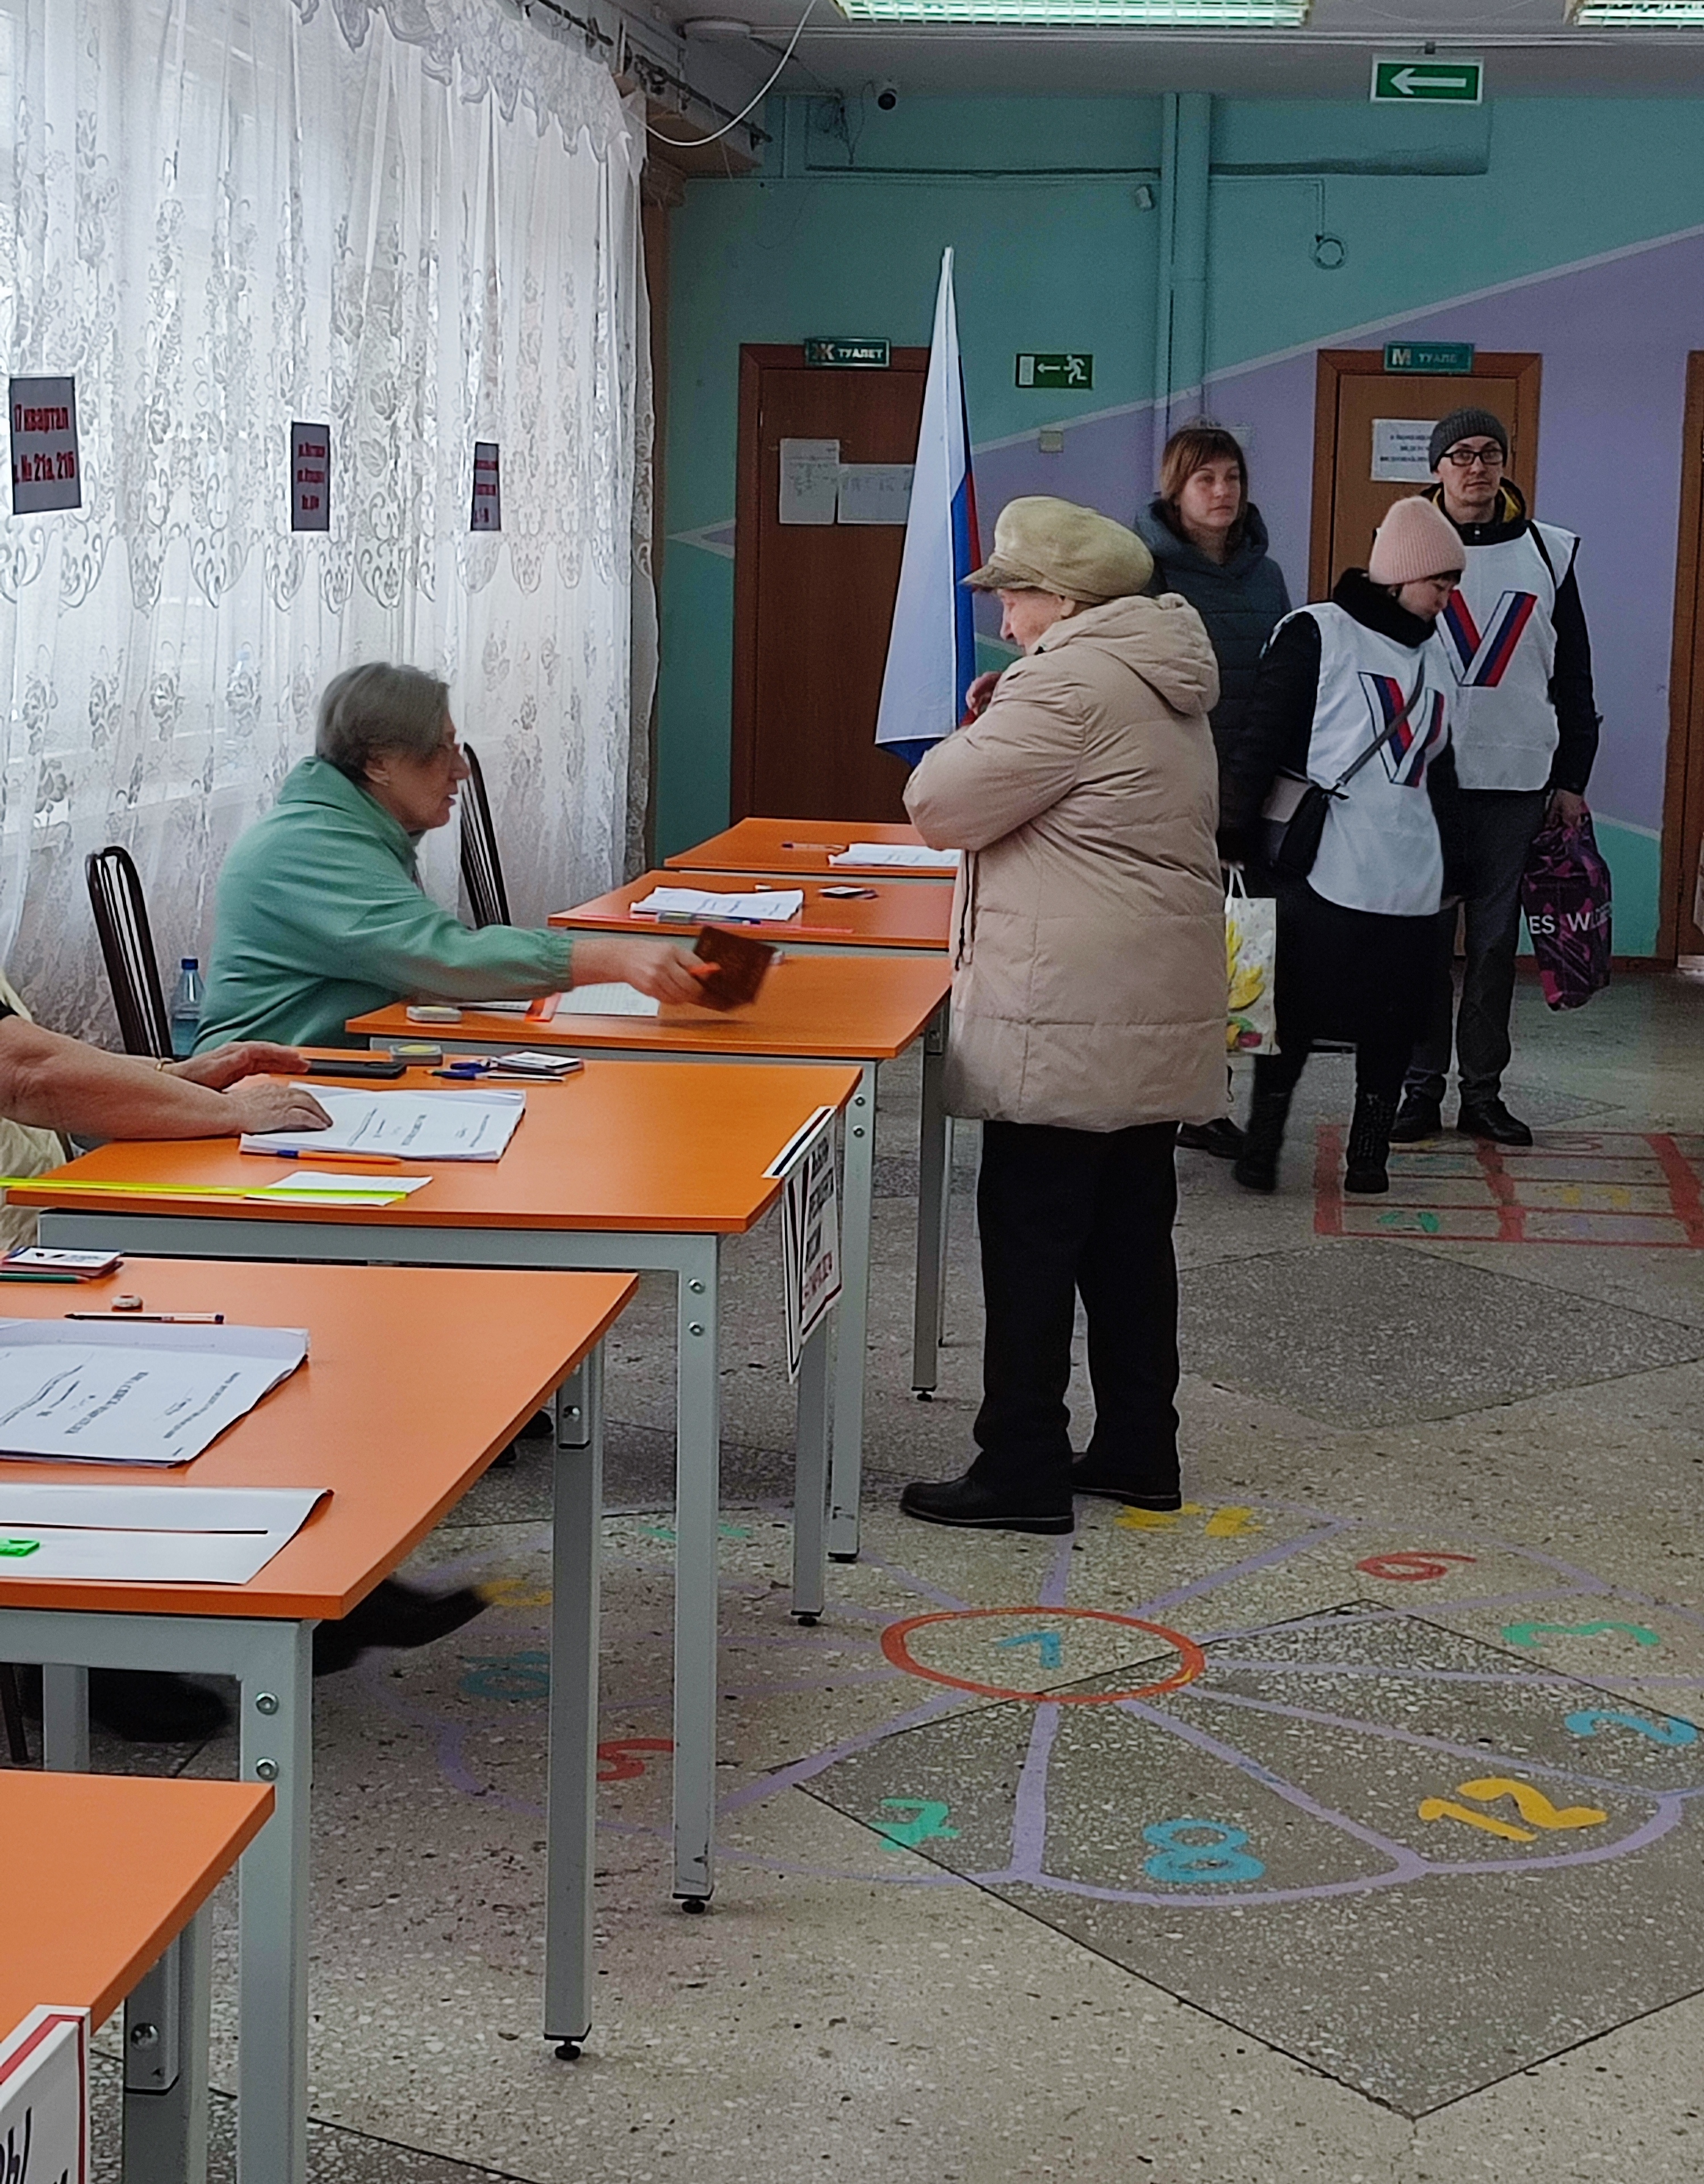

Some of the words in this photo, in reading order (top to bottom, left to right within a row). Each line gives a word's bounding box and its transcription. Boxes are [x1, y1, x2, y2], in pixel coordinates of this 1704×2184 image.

[812, 343, 835, 361] Ж
[838, 348, 884, 359] ТУАЛЕТ
[1392, 348, 1411, 366] М
[1418, 1777, 1608, 1841] 12
[1142, 1818, 1265, 1883] 8
